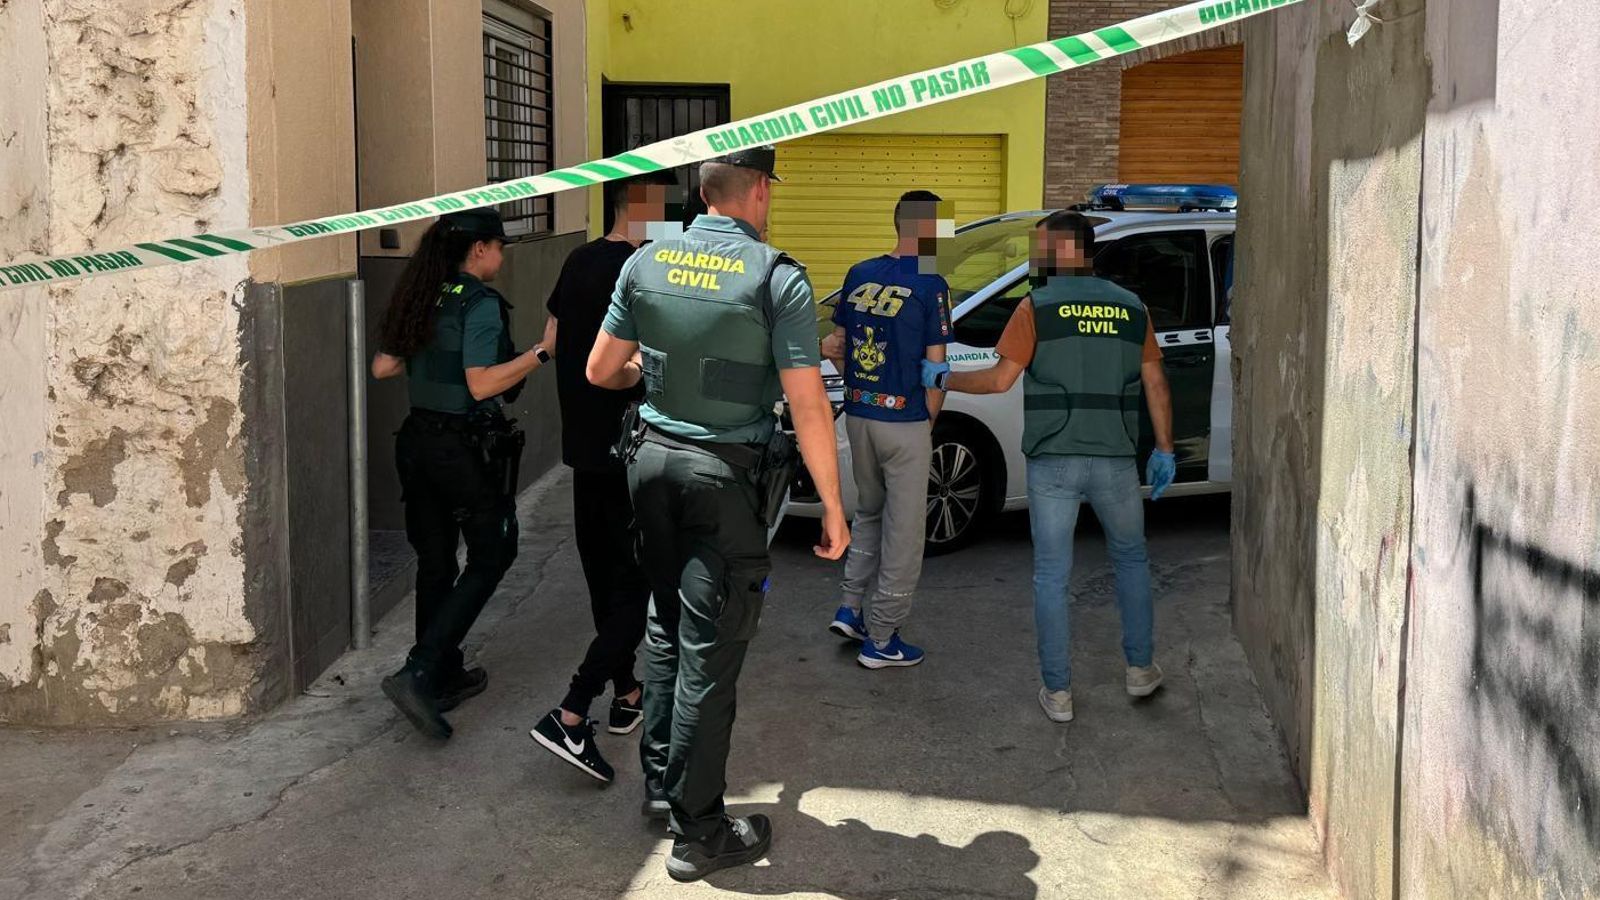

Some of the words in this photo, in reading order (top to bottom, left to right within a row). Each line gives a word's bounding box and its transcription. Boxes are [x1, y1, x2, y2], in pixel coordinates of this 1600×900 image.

[706, 112, 808, 152] GUARDIA
[809, 95, 869, 129] CIVIL
[872, 84, 907, 112] NO
[910, 61, 991, 102] PASAR
[281, 214, 378, 237] GUARDIA
[374, 204, 432, 221] CIVIL
[428, 197, 465, 212] NO
[461, 181, 538, 204] PASAR
[0, 263, 53, 284] CIVIL
[43, 259, 80, 278] NO
[71, 250, 143, 273] PASAR
[654, 249, 745, 274] GUARDIA
[667, 268, 721, 291] CIVIL
[847, 282, 912, 318] 46
[1058, 304, 1130, 321] GUARDIA
[1077, 321, 1119, 335] CIVIL
